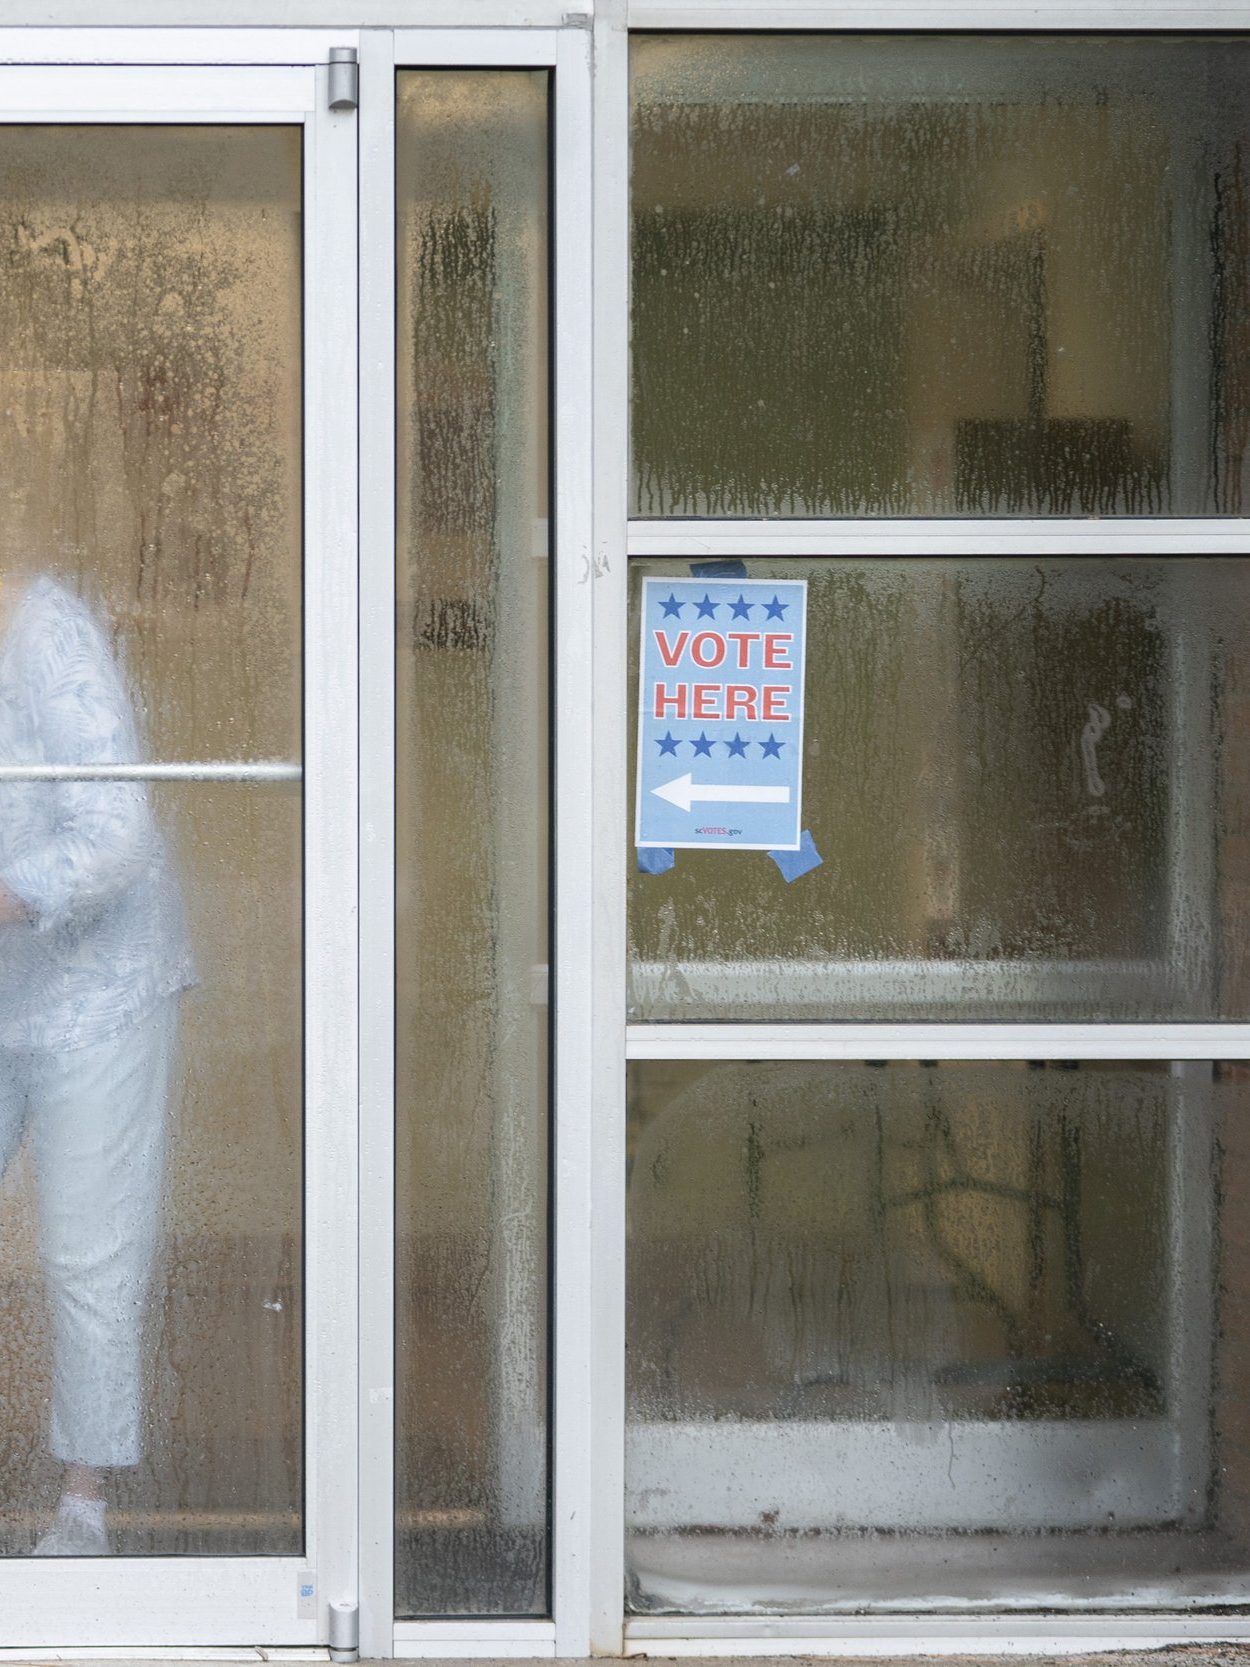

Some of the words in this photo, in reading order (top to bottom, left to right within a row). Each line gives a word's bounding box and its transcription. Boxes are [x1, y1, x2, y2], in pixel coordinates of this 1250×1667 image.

[654, 631, 793, 669] VOTE
[654, 683, 792, 721] HERE
[694, 826, 743, 836] scVOTES.gov
